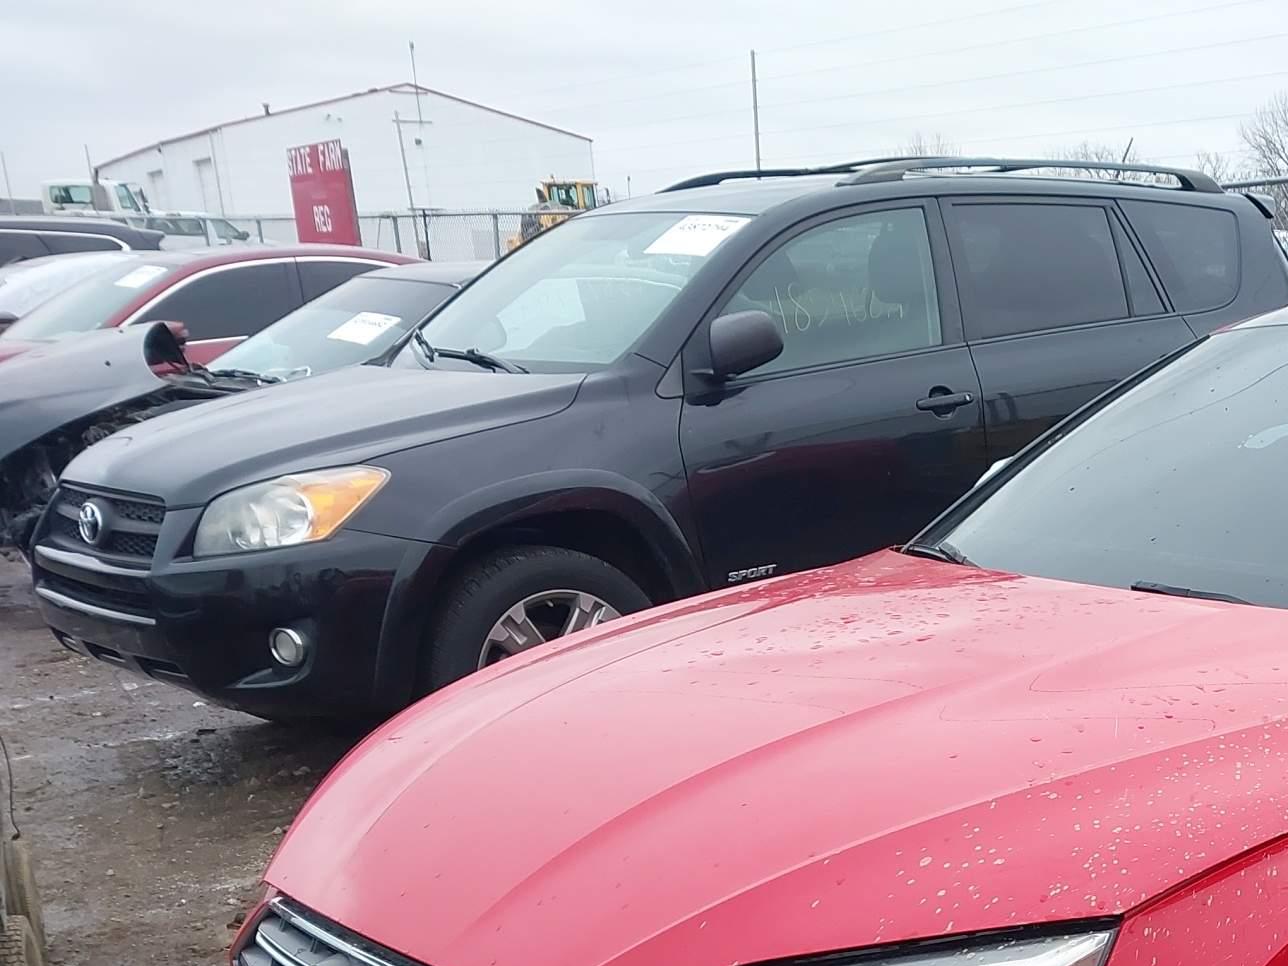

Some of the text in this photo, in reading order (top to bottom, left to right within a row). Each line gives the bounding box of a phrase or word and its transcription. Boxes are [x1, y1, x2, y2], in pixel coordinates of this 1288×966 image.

[287, 142, 343, 176] STATE FARM
[312, 204, 332, 232] REG
[727, 564, 777, 582] SPORT
